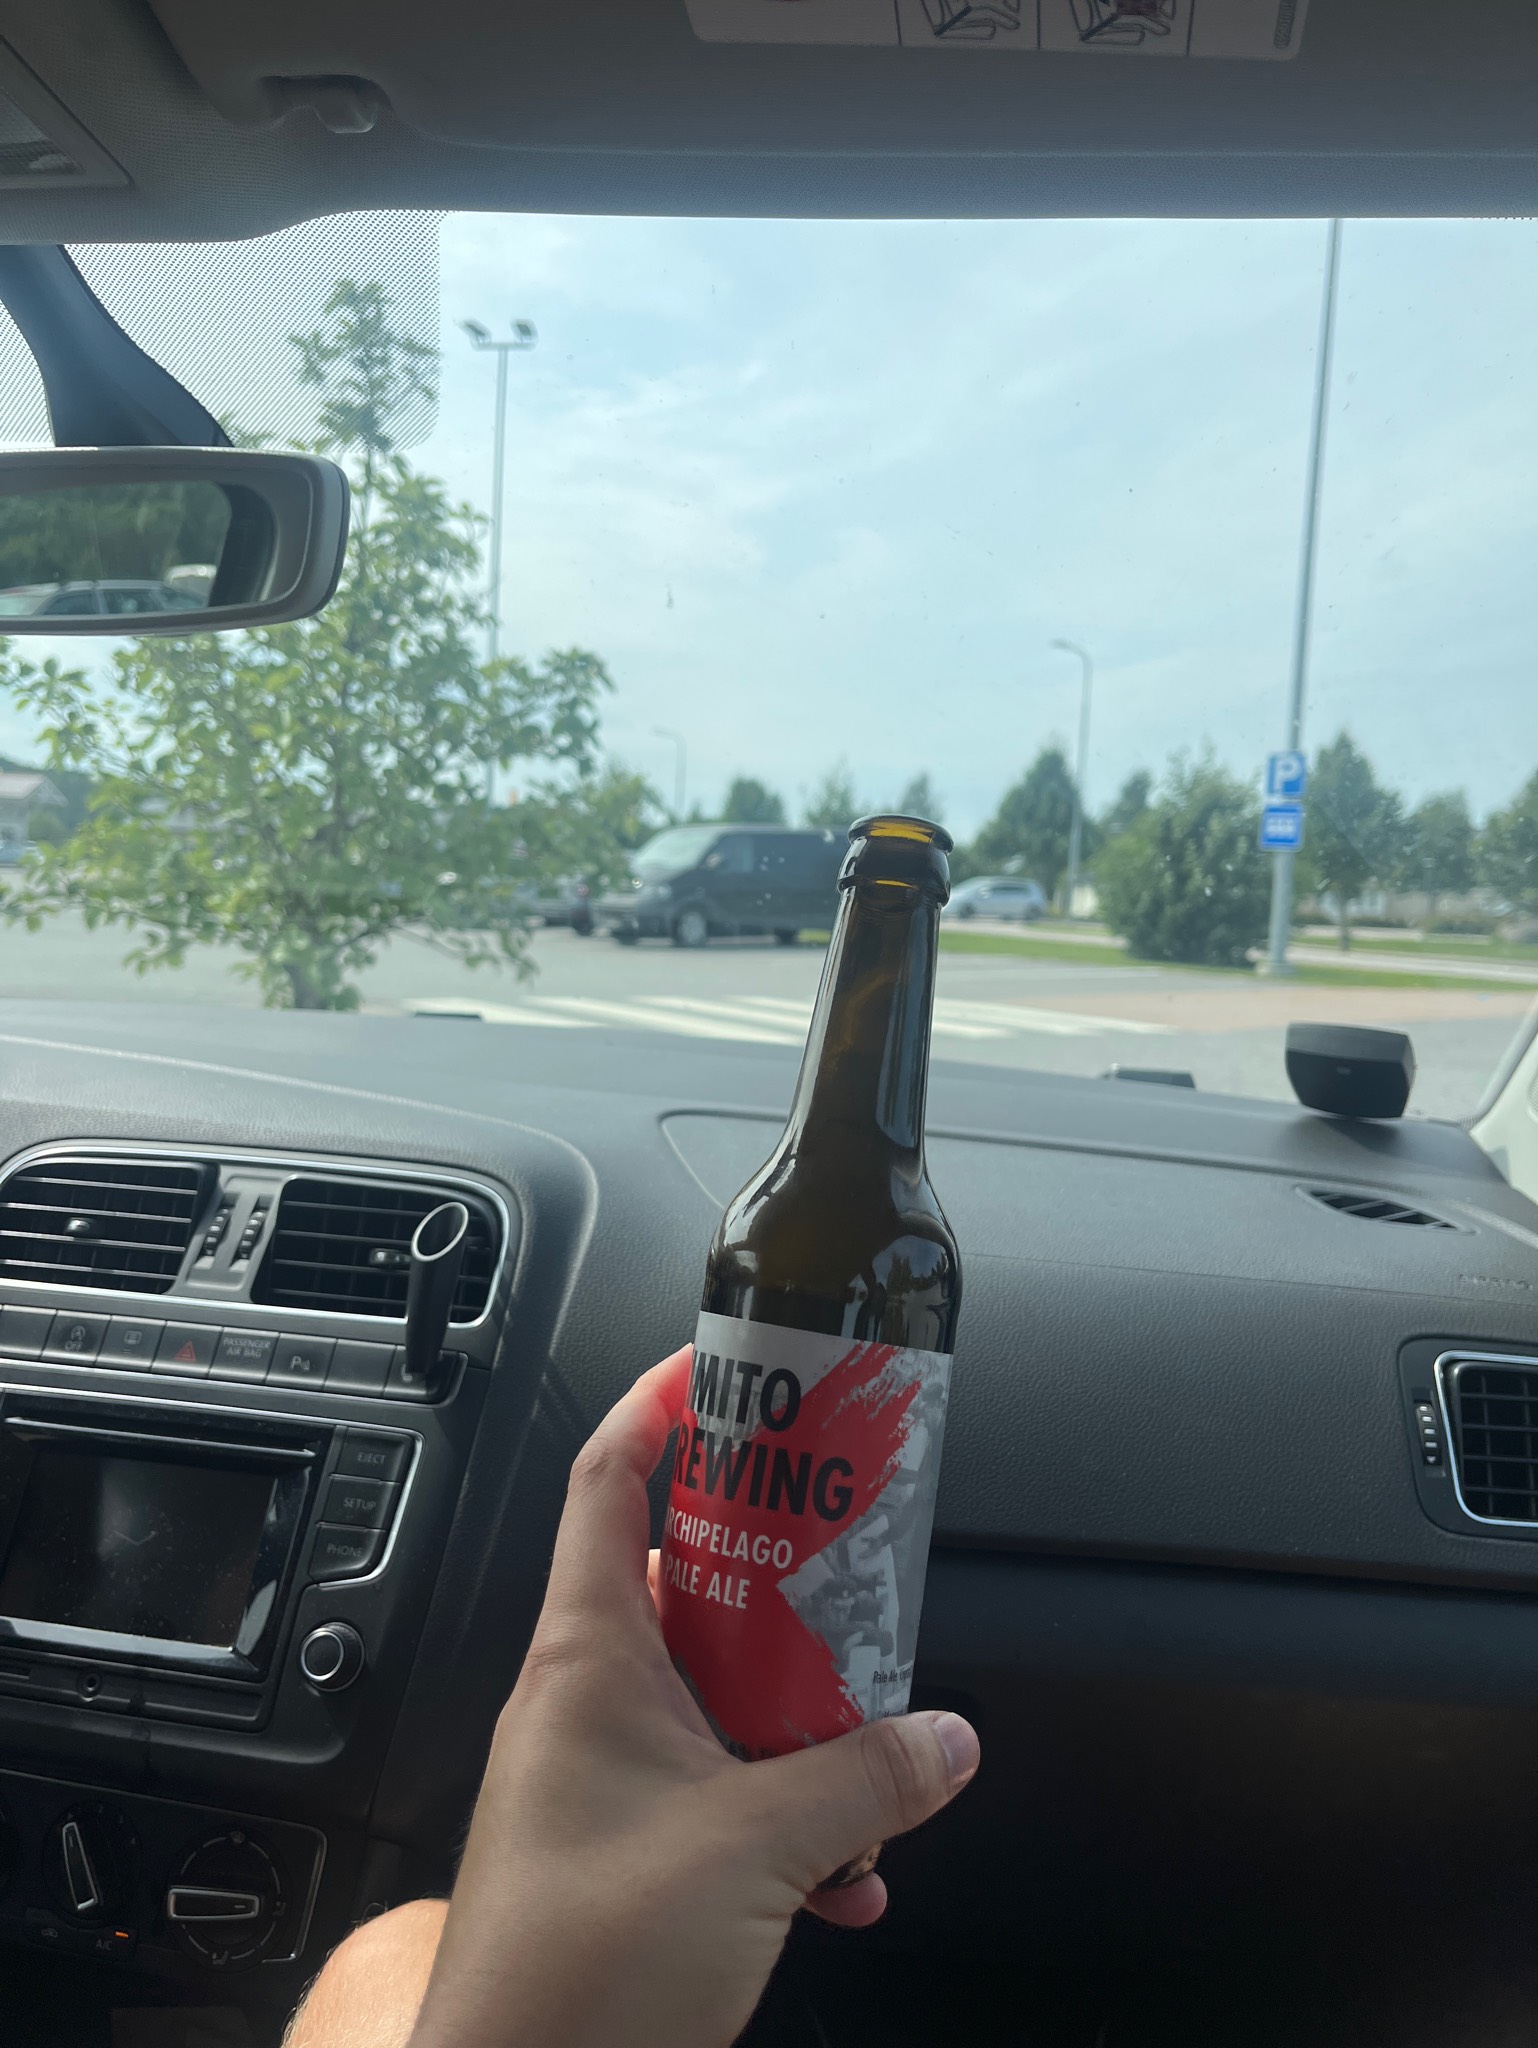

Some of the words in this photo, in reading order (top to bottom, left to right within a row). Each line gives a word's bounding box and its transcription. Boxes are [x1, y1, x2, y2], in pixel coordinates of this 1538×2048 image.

[1275, 756, 1300, 795] P
[223, 1337, 271, 1350] PASSENGER
[226, 1347, 242, 1357] AIR
[244, 1349, 262, 1359] BAG
[357, 1452, 386, 1465] EJECT
[343, 1496, 376, 1511] SETUP
[326, 1543, 364, 1557] PHONE
[665, 1554, 701, 1595] PALE
[705, 1571, 751, 1610] ALE
